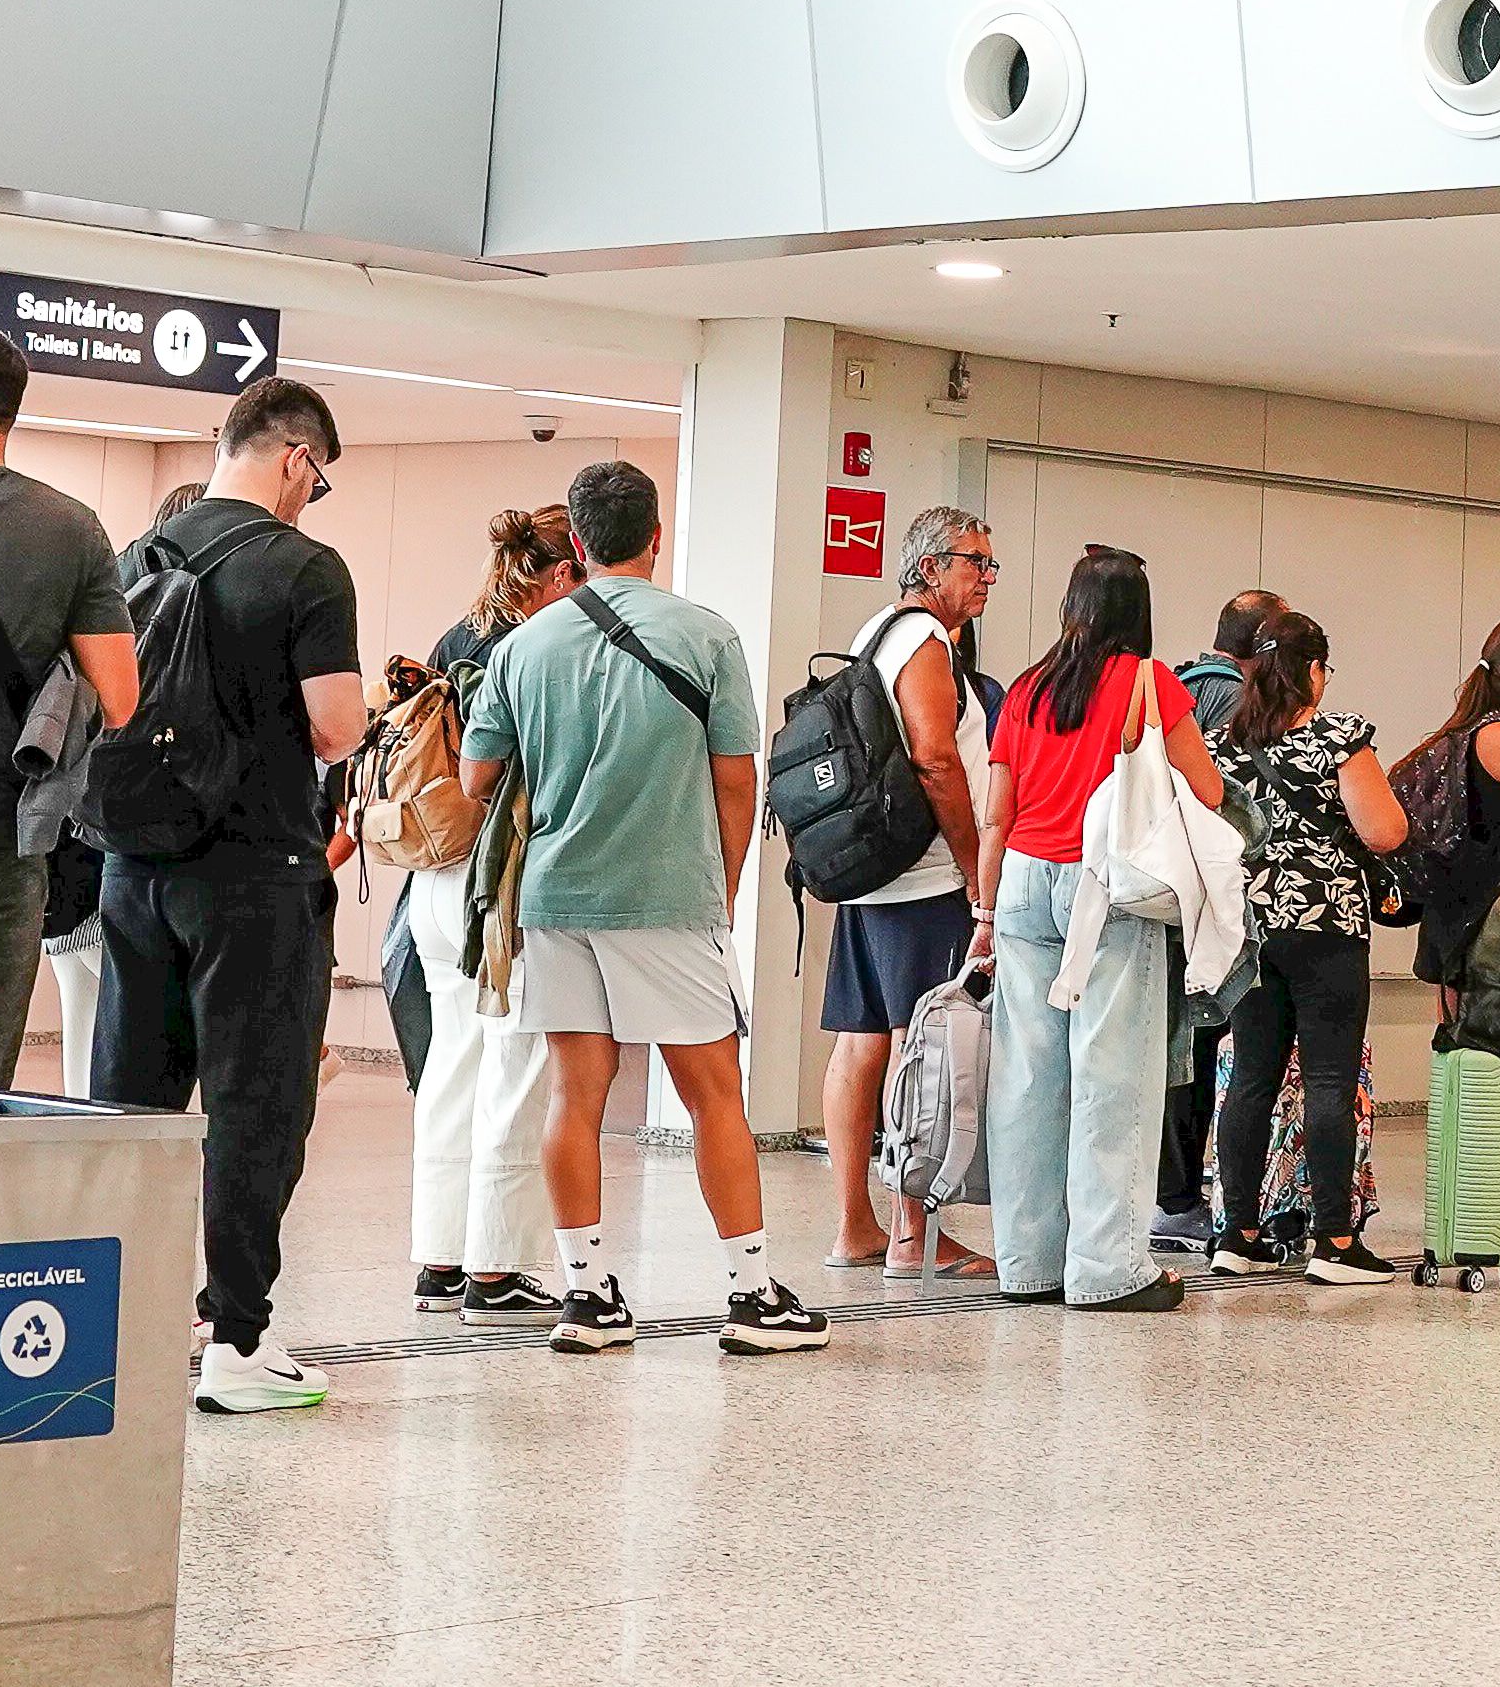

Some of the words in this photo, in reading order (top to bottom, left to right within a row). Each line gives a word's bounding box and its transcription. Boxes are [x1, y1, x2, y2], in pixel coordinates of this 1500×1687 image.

[16, 291, 144, 335] Sanitários
[26, 332, 78, 356] Toilets
[93, 341, 141, 363] Baños
